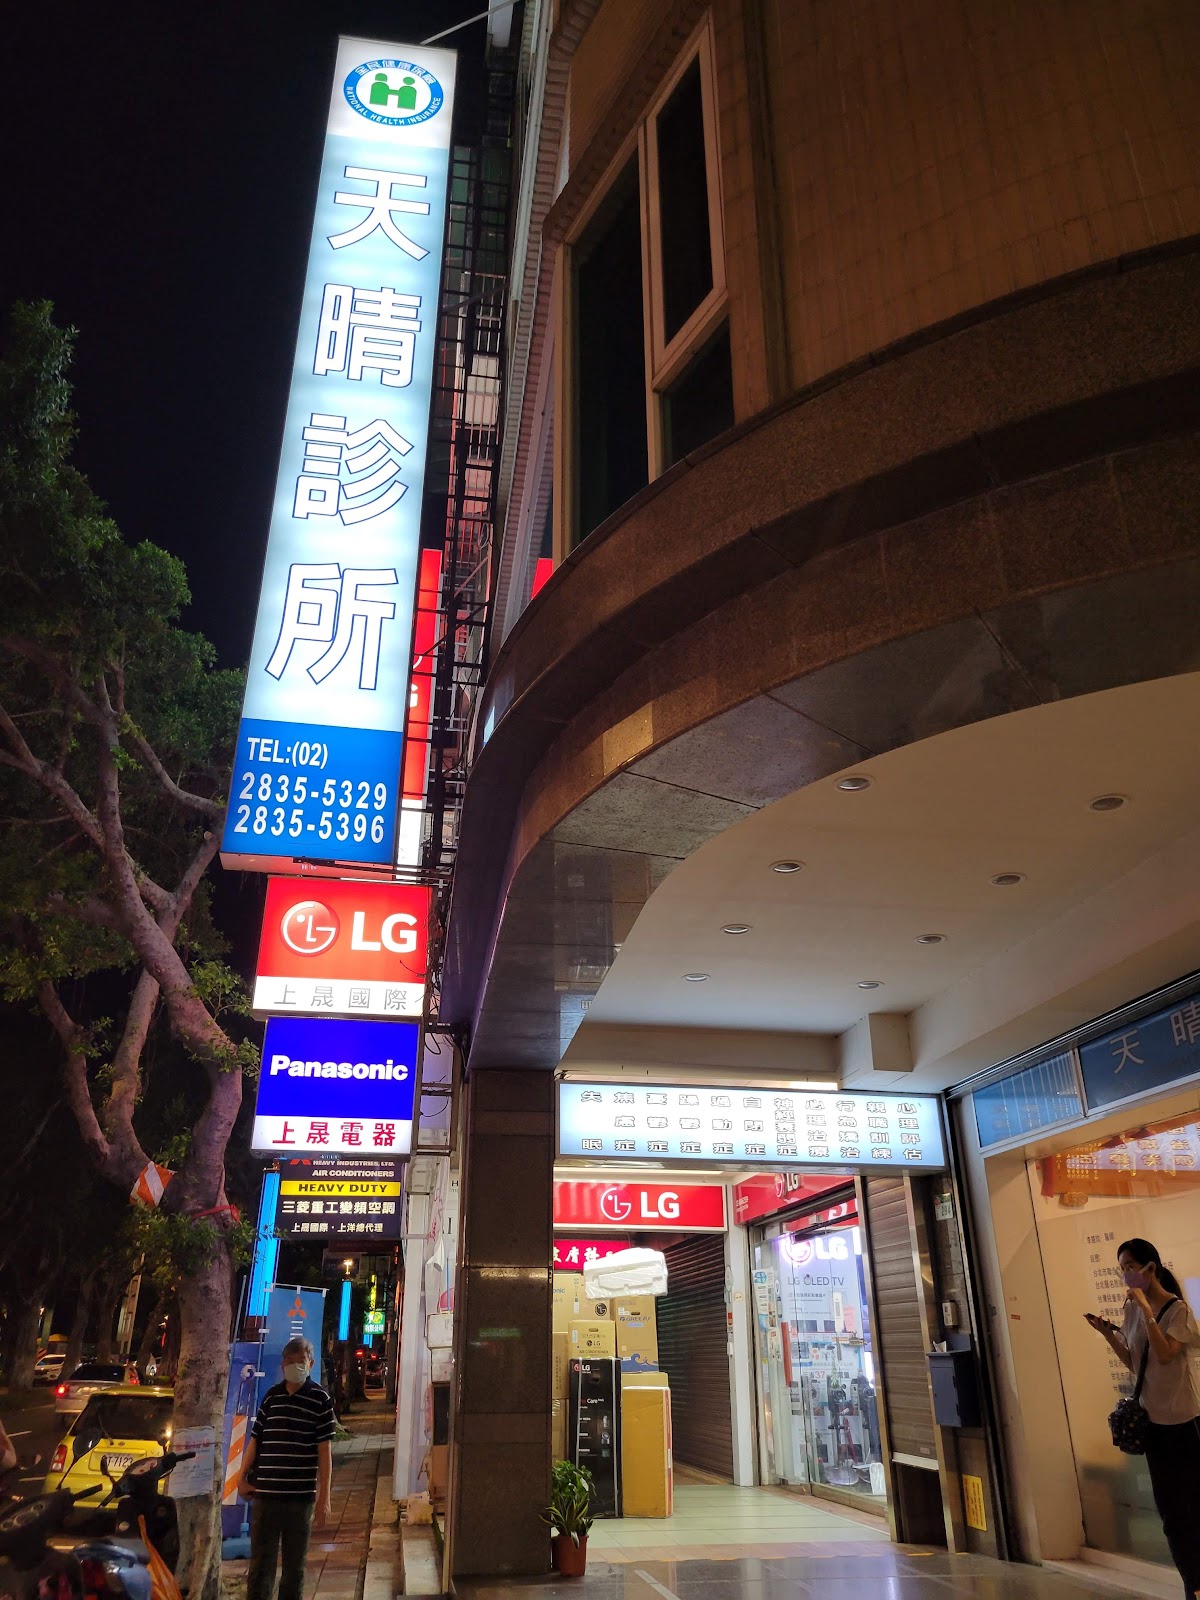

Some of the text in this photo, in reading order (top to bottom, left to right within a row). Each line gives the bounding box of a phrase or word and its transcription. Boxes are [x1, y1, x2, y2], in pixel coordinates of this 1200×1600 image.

[345, 86, 441, 126] NATIONAL HEALTH INSURANCE
[264, 165, 431, 691] 天晴診所
[247, 737, 329, 769] TEL:(02)
[238, 771, 387, 811] 2835-5329
[233, 804, 385, 844] 2835-5396
[351, 911, 418, 953] LG
[273, 983, 407, 1011] 上晟國際
[270, 1054, 409, 1081] Panasonic
[272, 1120, 396, 1147] 上晟電器
[613, 1092, 636, 1152] 焦慮症
[711, 1095, 734, 1155] 過動症
[743, 1096, 766, 1155] 自閉症
[774, 1097, 798, 1157] 神經衰弱症
[805, 1098, 830, 1158] 心理治療
[836, 1100, 860, 1159] 行為矯治
[866, 1101, 892, 1160] 親職訓練
[897, 1102, 923, 1161] 心理評估
[298, 1183, 388, 1193] HEAVY DUTY
[312, 1169, 327, 1177] AIR
[787, 1173, 799, 1192] LG
[281, 1200, 396, 1215] 三菱重工變頻空調
[640, 1191, 680, 1219] LG
[814, 1236, 849, 1260] LG
[788, 1274, 845, 1287] LG OLED TV
